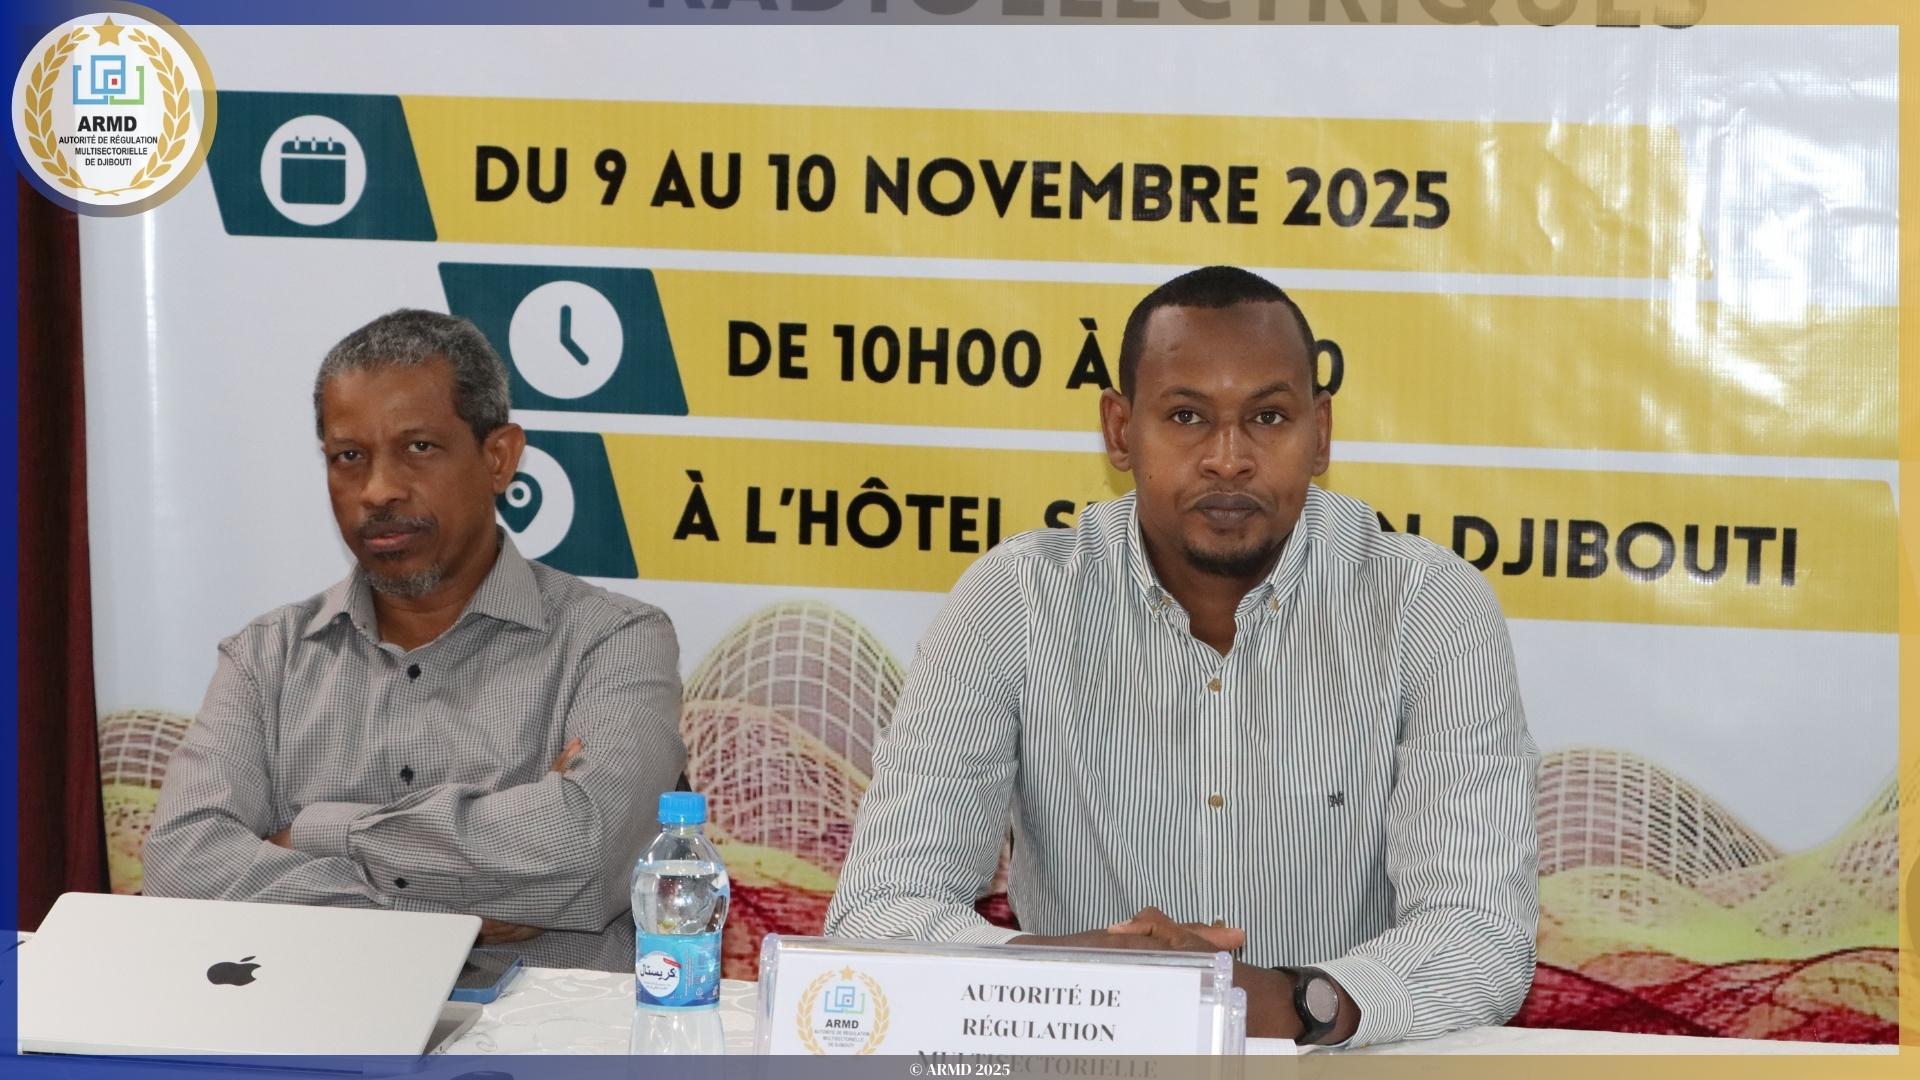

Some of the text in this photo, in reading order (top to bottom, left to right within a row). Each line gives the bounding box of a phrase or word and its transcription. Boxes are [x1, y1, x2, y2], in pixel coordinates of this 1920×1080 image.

[475, 145, 1450, 230] DU 9 AU 10 NOVEMBRE 2025
[728, 317, 1111, 391] DE 10H00 À
[673, 469, 720, 542] À
[1453, 514, 1798, 587] DJIBOUTI
[961, 984, 1121, 1008] AUTORITÉ DE
[825, 1019, 859, 1029] ARMD
[962, 1014, 1116, 1042] RÉGULATION
